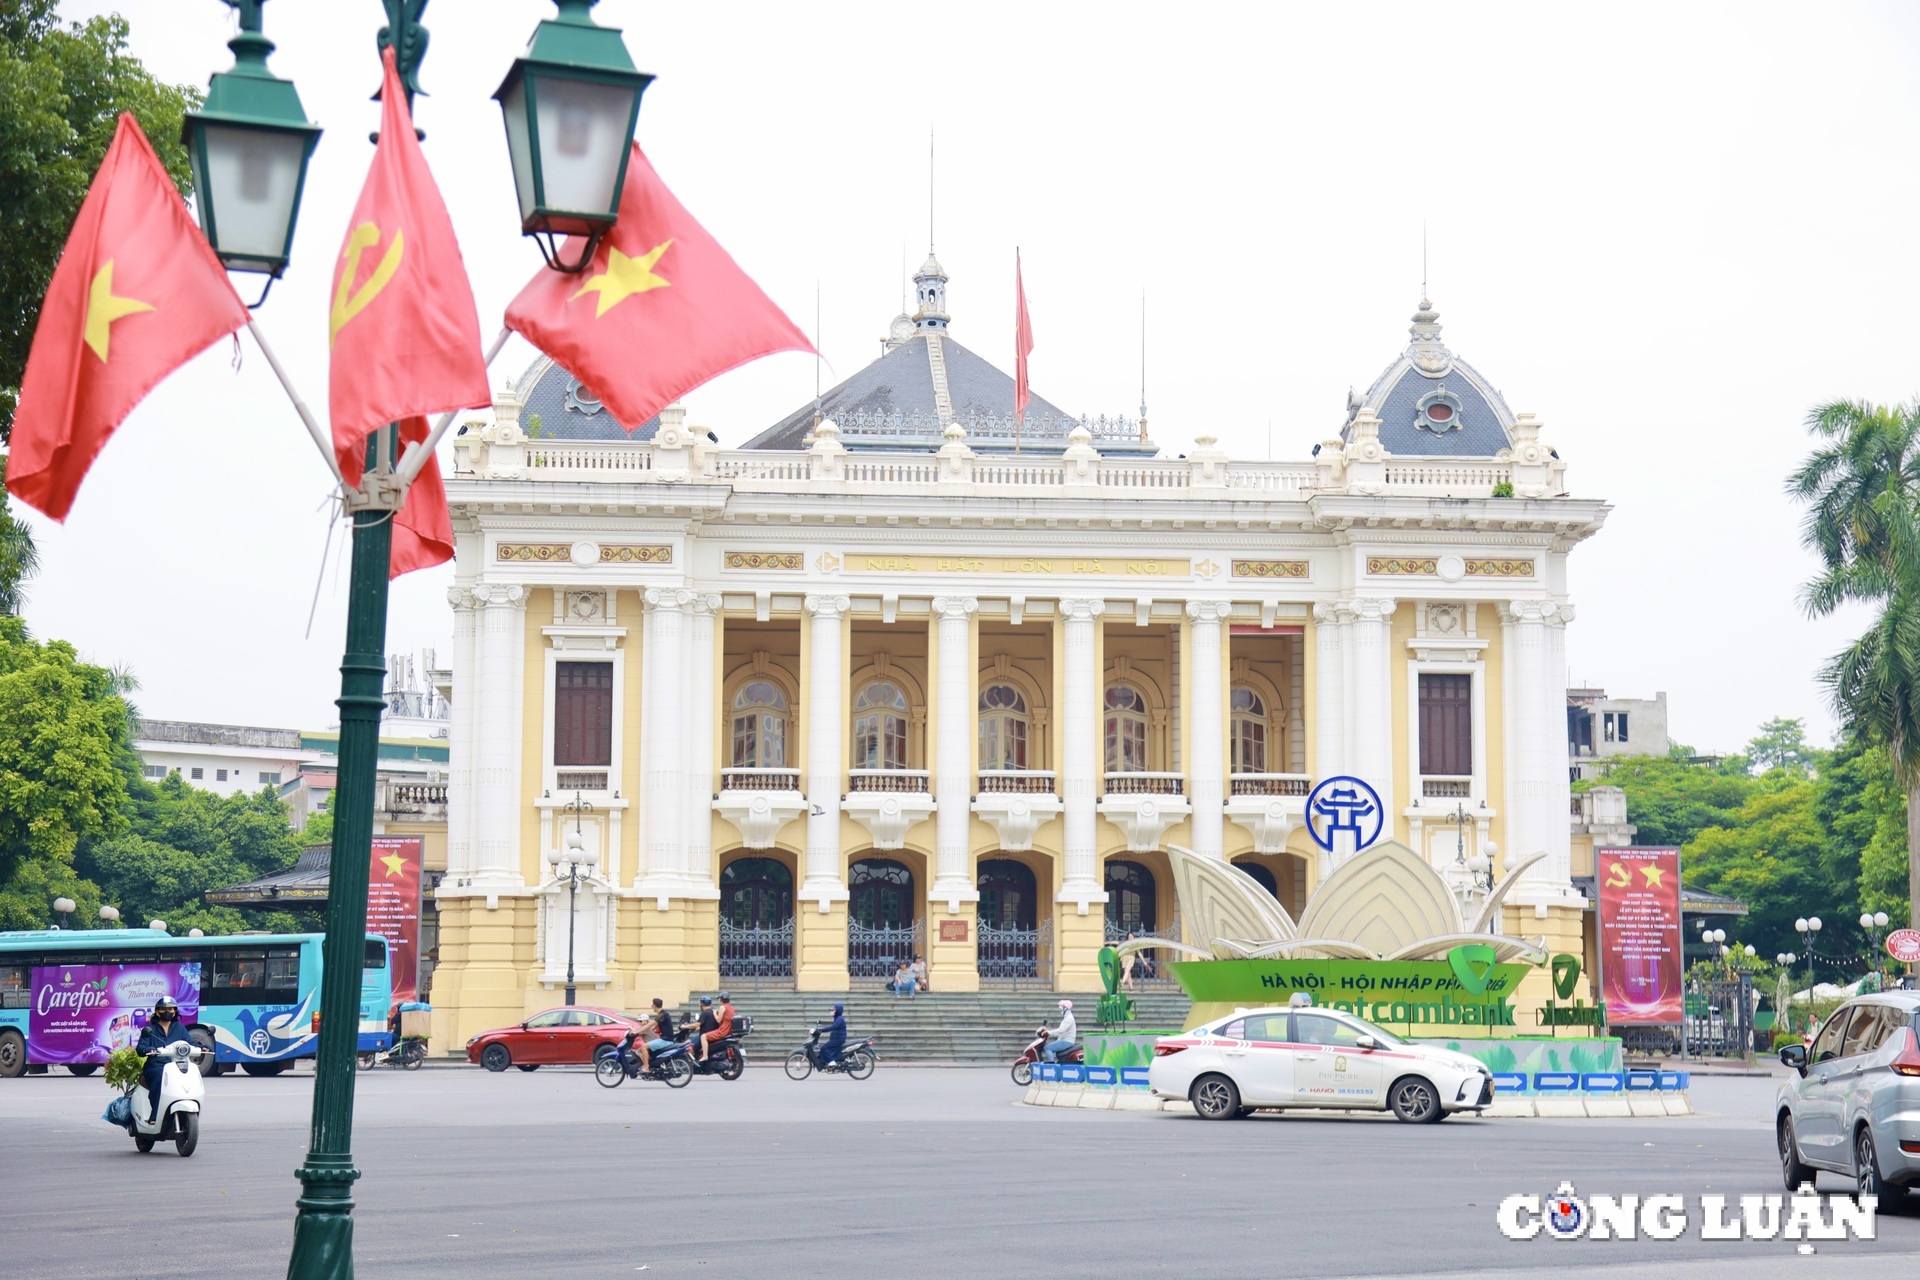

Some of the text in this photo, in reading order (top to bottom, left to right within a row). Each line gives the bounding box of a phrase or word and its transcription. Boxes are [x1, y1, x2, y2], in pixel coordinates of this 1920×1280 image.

[866, 555, 1167, 575] NHÀ HÁT LỚN HÀ NỘI
[1261, 973, 1288, 988] HÀ
[1291, 973, 1325, 992] NỘI
[1341, 974, 1375, 993] HỘI
[1381, 974, 1432, 993] NHẬP
[37, 983, 106, 1017] Carefor
